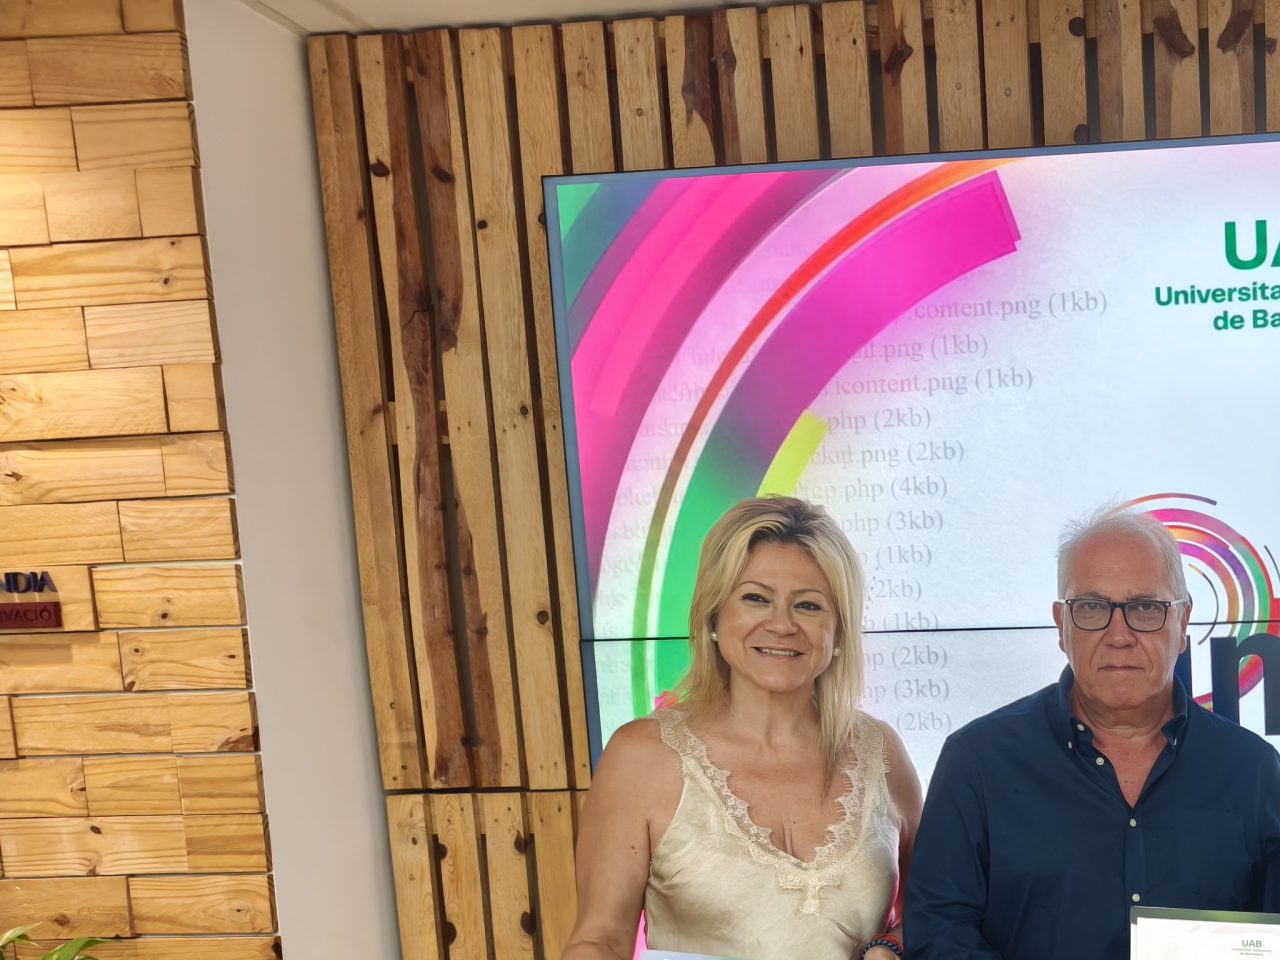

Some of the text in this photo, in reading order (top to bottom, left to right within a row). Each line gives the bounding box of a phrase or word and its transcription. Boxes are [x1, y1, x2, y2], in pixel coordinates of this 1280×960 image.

[1048, 289, 1108, 318] (1kb)
[1212, 310, 1245, 331] de
[930, 333, 989, 359] (1kb)
[974, 366, 1034, 392] (1kb)
[873, 407, 932, 432] (2kb)
[906, 440, 965, 465] (2kb)
[890, 475, 948, 500] (4kb)
[886, 509, 944, 535] (3kb)
[1241, 939, 1262, 948] UAB
